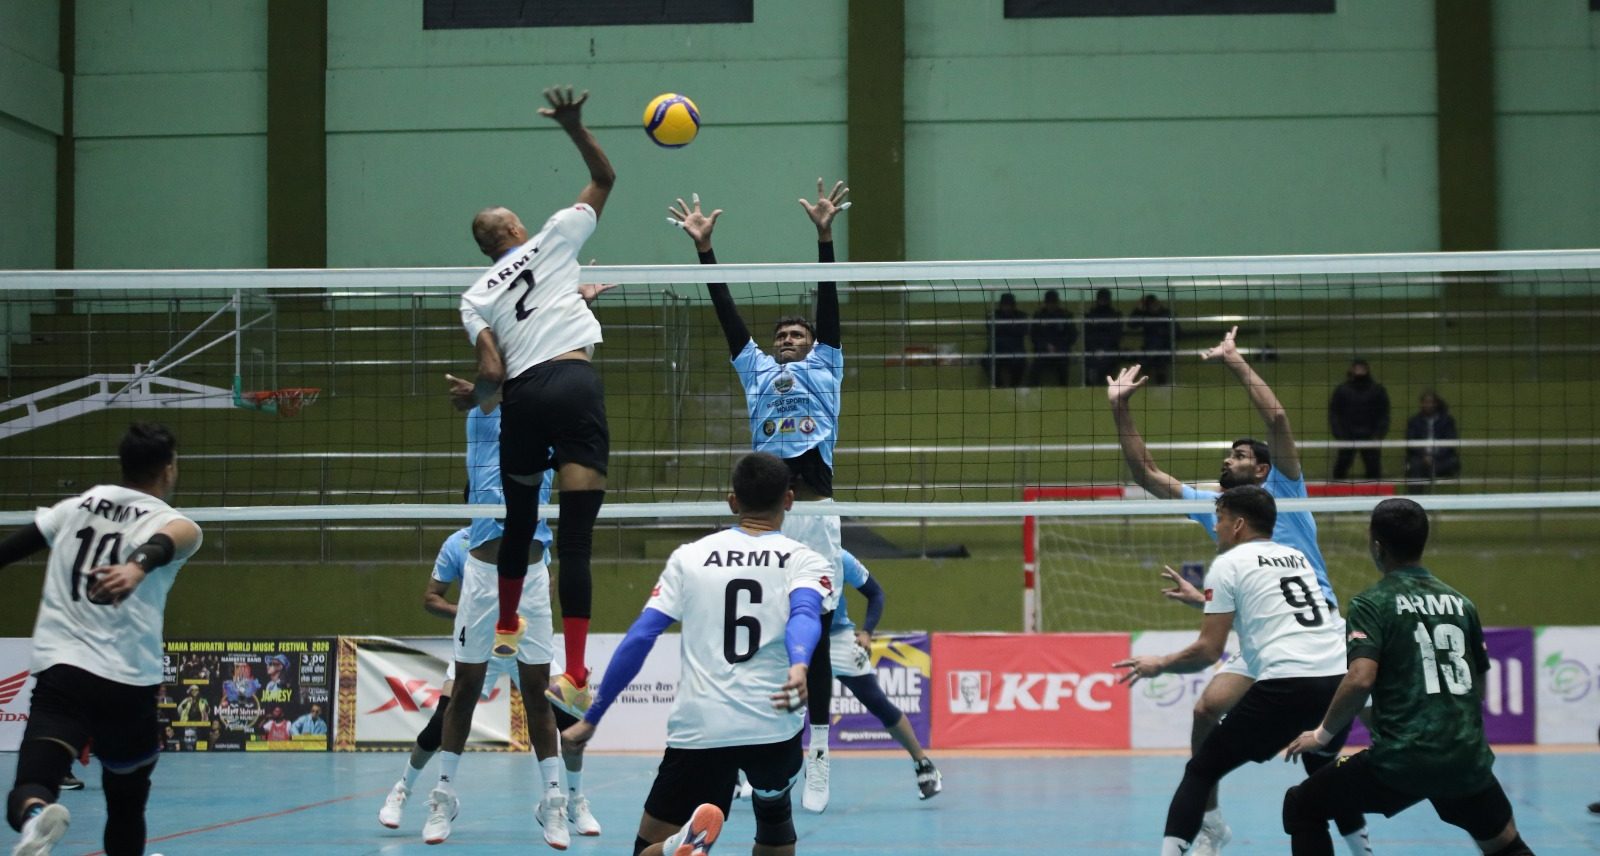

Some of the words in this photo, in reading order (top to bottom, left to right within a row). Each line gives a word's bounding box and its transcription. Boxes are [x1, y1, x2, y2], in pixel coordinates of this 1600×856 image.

[487, 243, 540, 289] ARMY
[508, 269, 538, 321] 2
[78, 496, 149, 521] ARMY
[71, 525, 130, 605] 10
[703, 550, 791, 568] ARMY
[1257, 554, 1307, 569] ARMY
[1280, 576, 1324, 628] 9
[1396, 593, 1465, 617] ARMY
[723, 578, 763, 665] 6
[168, 641, 188, 652] MAHA
[190, 641, 225, 652] SHIVRATRI
[226, 641, 251, 652] WORLD
[252, 641, 275, 652] MUSIC
[278, 641, 308, 652] FESTIVAL
[458, 625, 466, 647] 4
[1414, 621, 1473, 695] 13
[308, 694, 329, 703] TEAM
[622, 695, 649, 703] Bikas
[995, 672, 1114, 712] KFC
